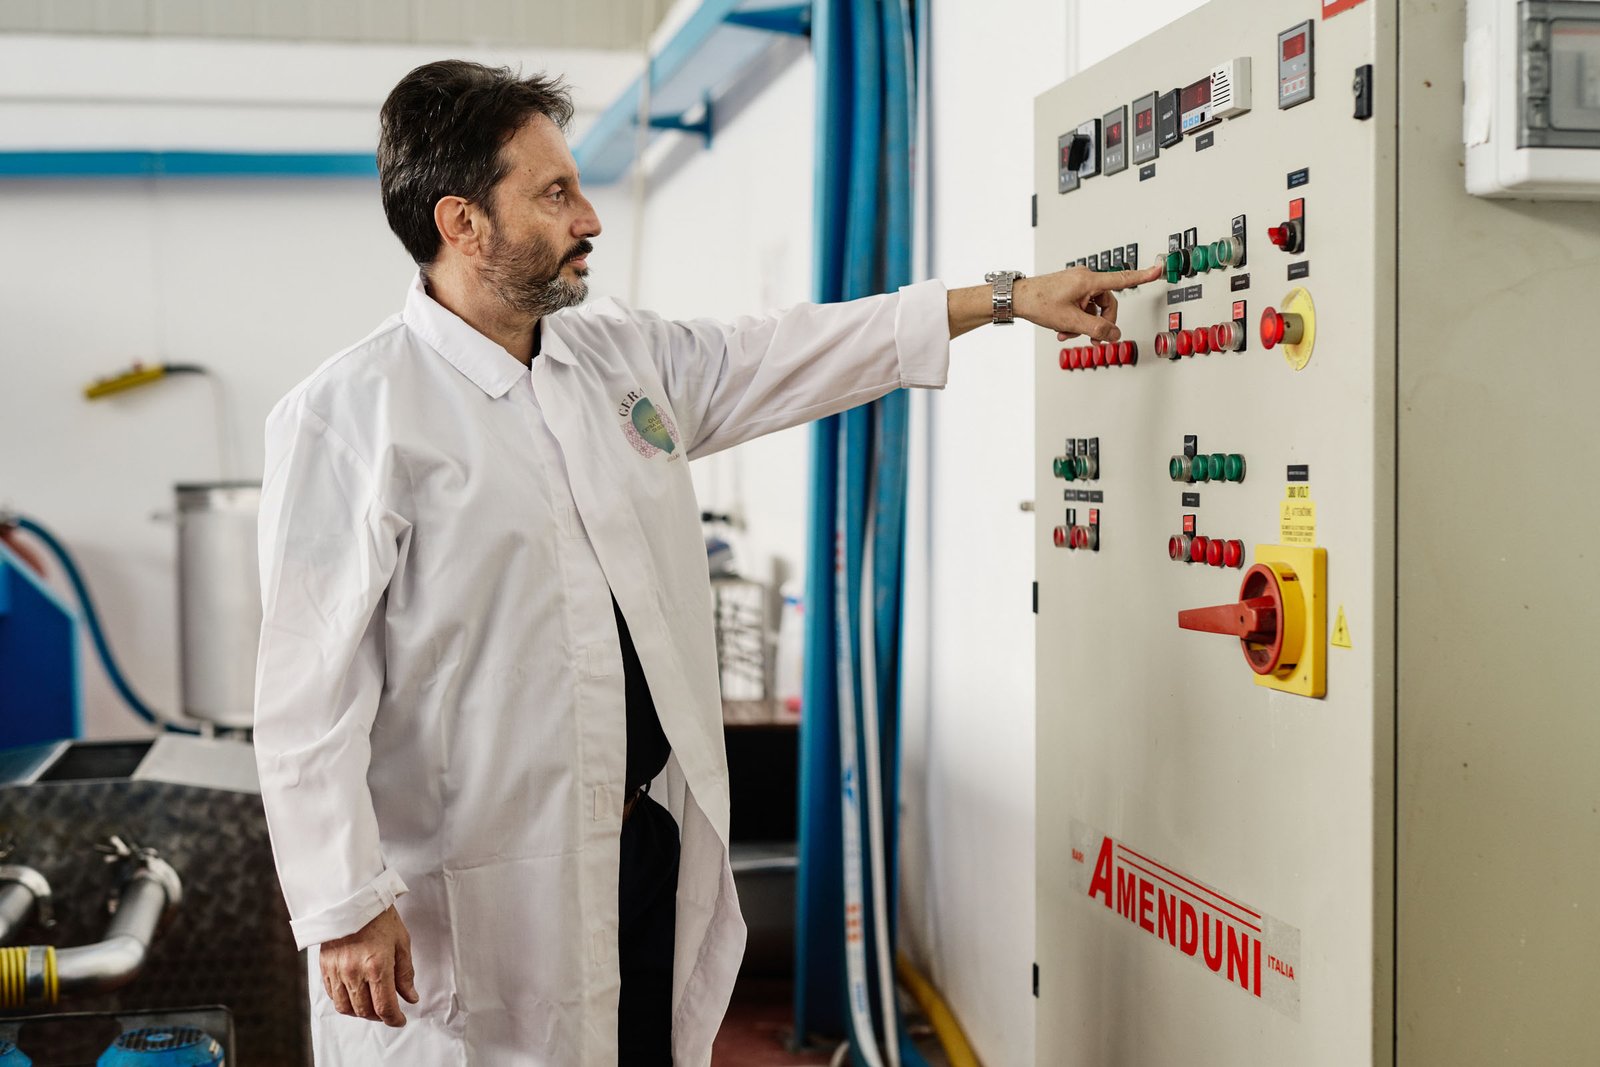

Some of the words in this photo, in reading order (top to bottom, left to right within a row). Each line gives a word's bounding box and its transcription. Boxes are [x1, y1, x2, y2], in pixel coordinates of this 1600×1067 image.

[1297, 486, 1309, 498] VOLT
[1088, 836, 1261, 997] AMENDUNI
[1267, 954, 1295, 981] ITALIA
